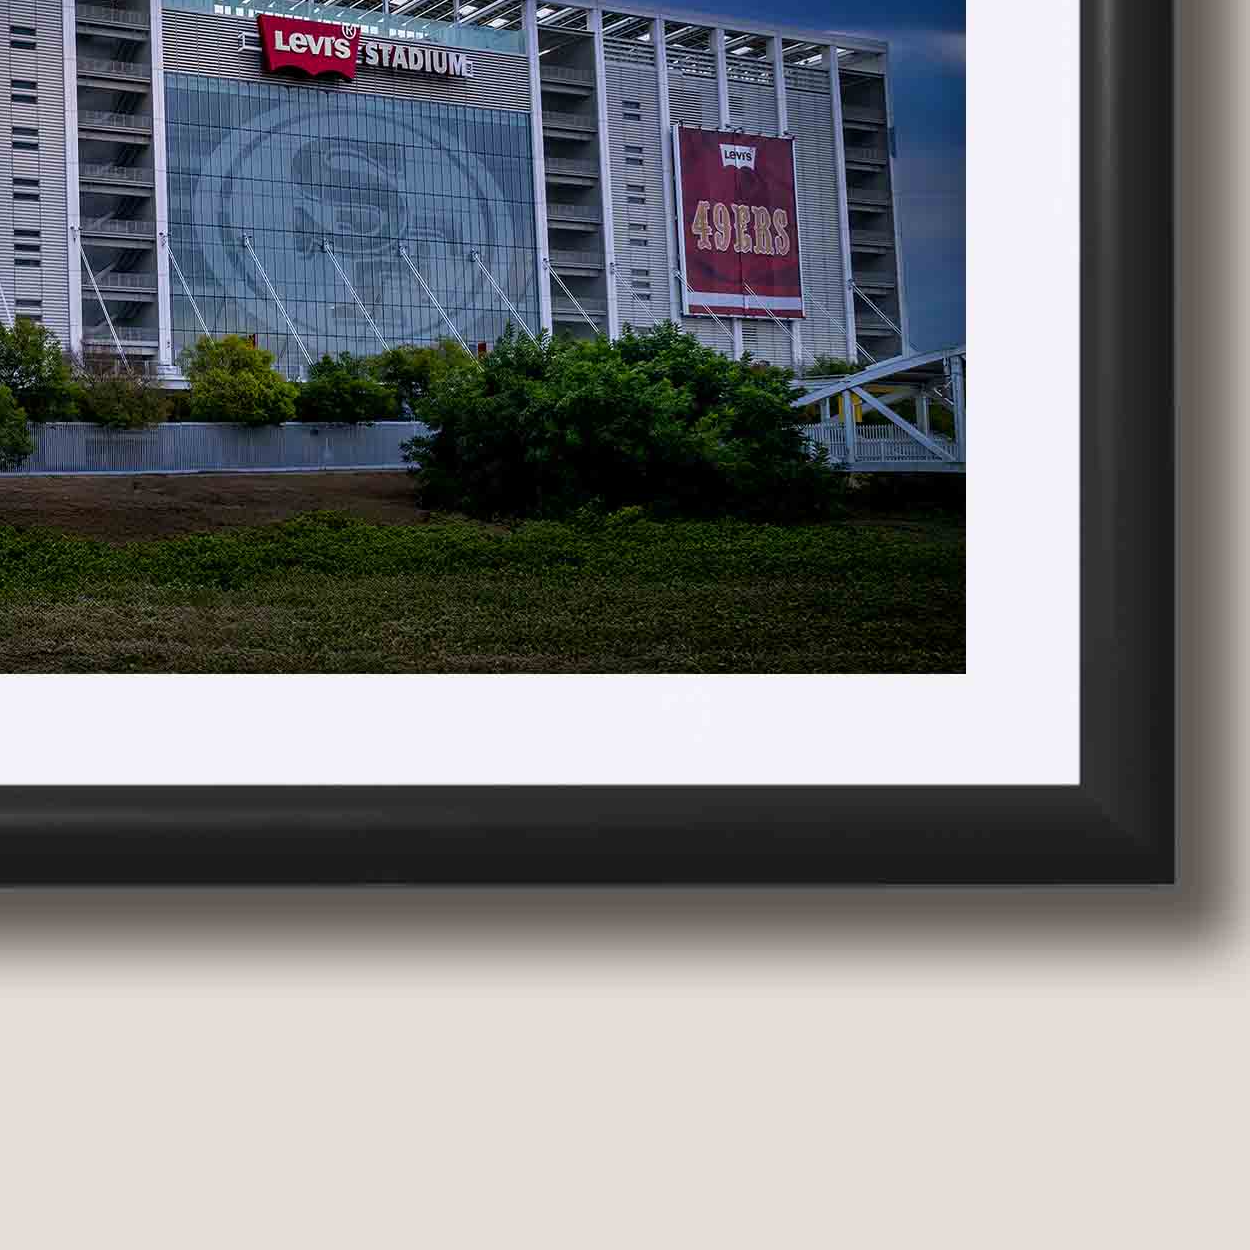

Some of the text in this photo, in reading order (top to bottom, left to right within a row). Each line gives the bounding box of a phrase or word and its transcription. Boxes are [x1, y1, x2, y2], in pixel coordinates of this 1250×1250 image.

[273, 30, 469, 78] Levi's STADIUM
[691, 200, 791, 257] 49ERS
